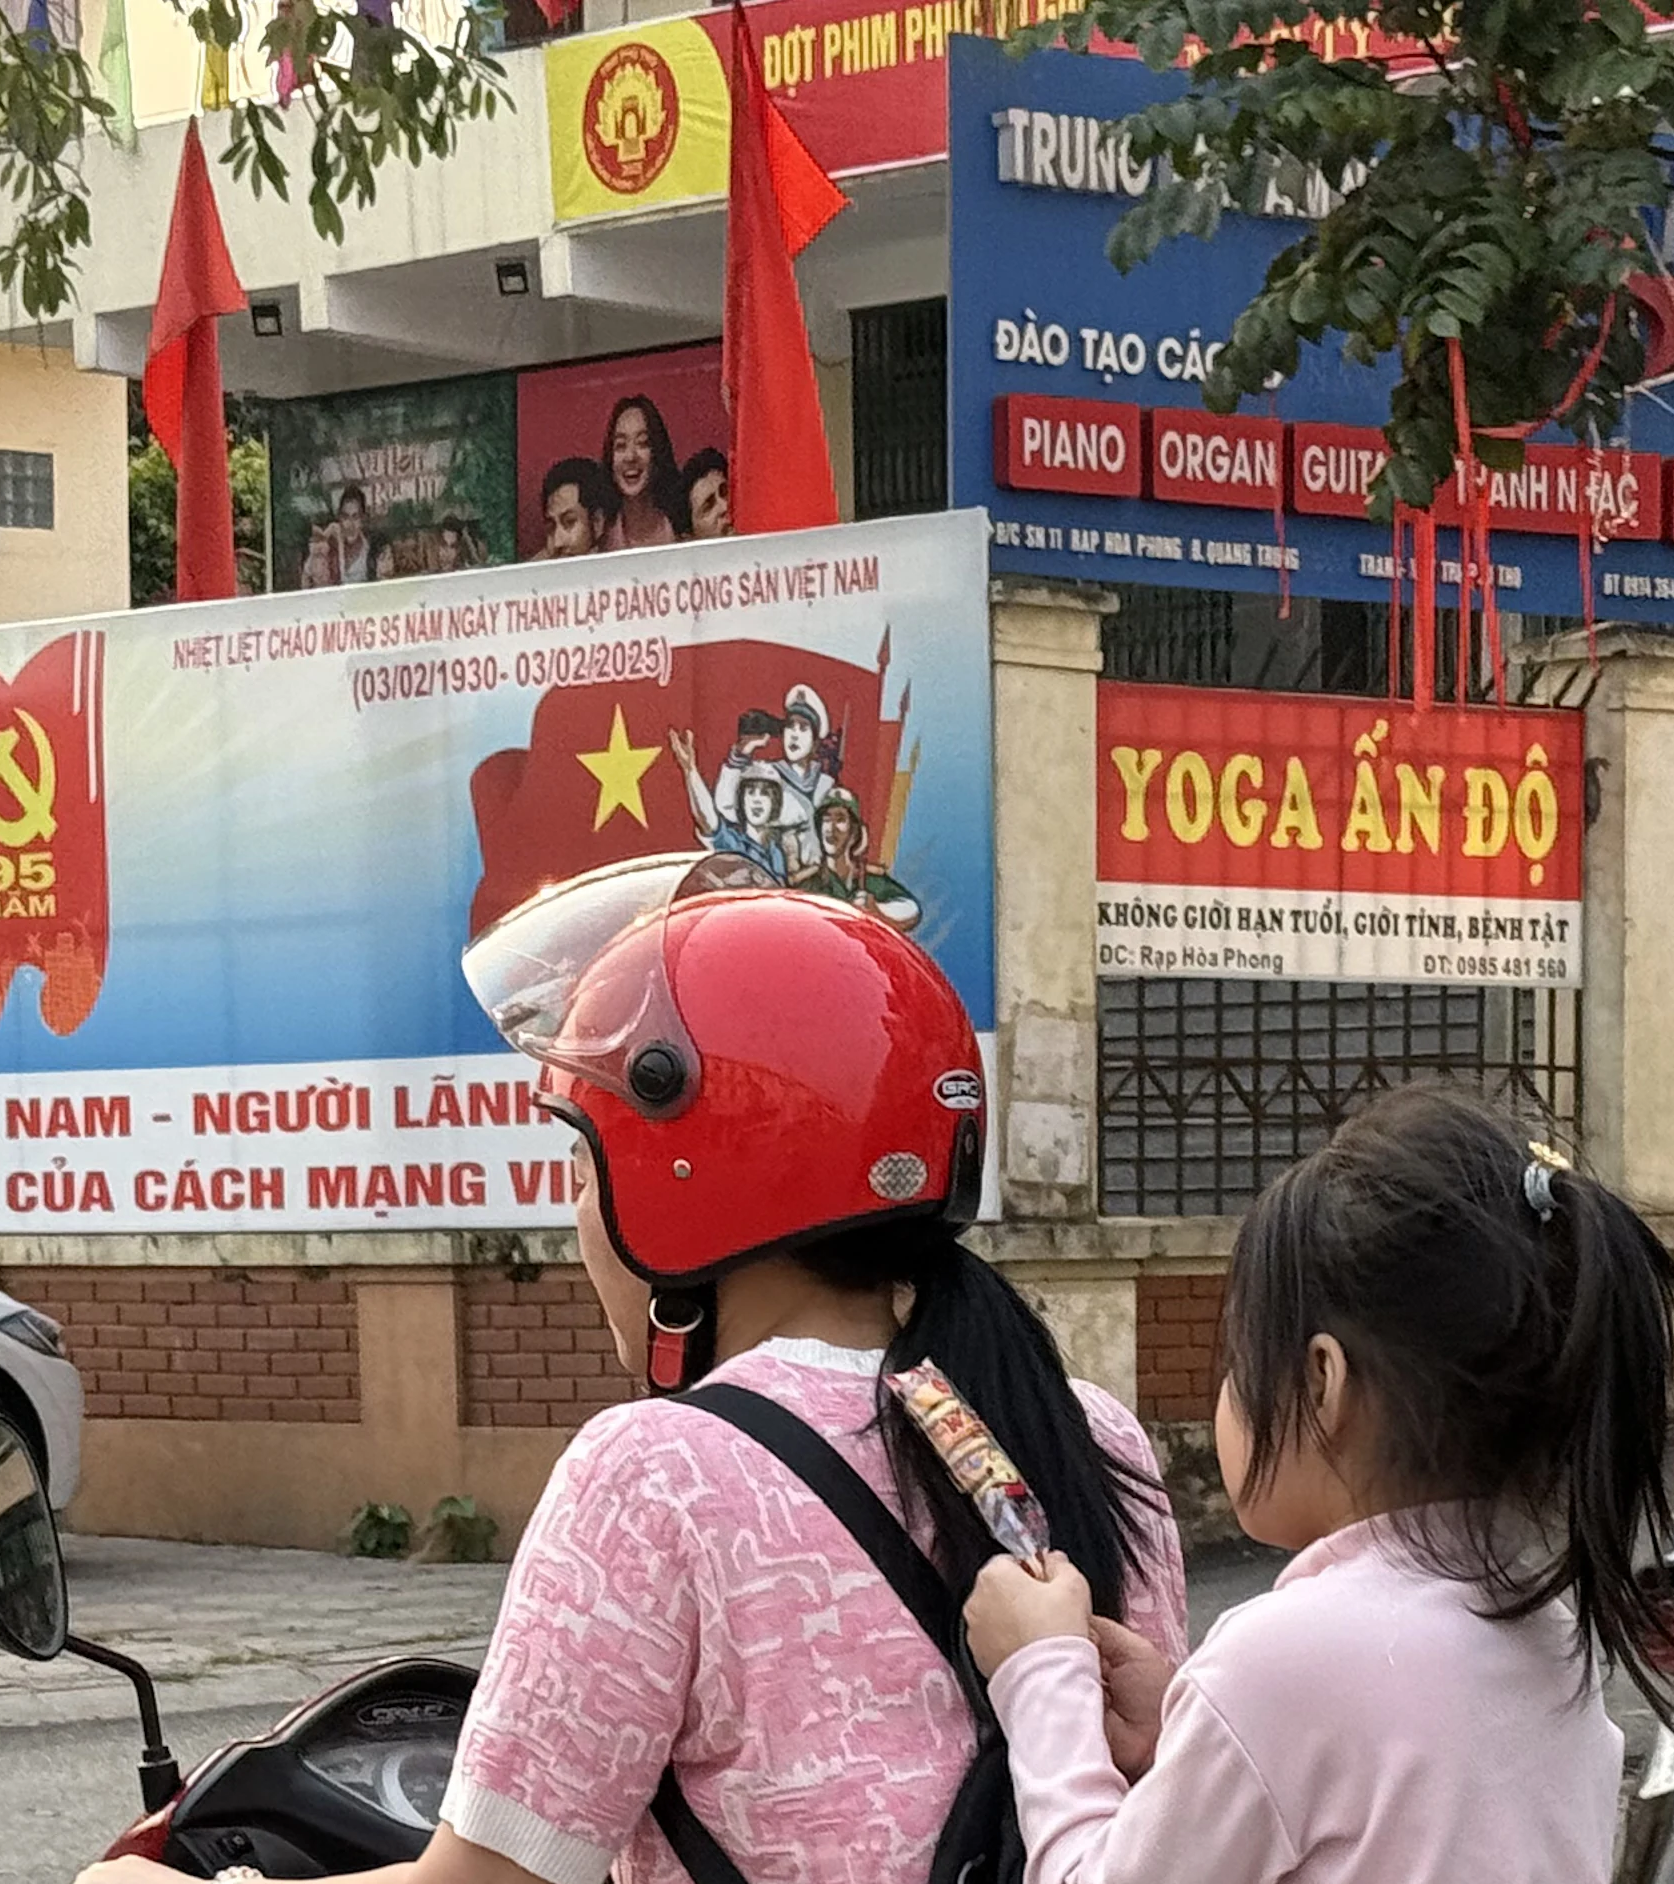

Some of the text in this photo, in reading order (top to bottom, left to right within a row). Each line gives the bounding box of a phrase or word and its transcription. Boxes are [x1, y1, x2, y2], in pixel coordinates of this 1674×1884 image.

[763, 23, 817, 98] ĐỢT
[824, 10, 898, 79] PHIM
[995, 307, 1070, 367] ĐÀO
[1079, 327, 1147, 384] TẠO
[1023, 416, 1126, 475] PIANO
[1159, 429, 1277, 488] ORGAN
[1302, 444, 1391, 497] GUIT
[379, 618, 402, 648] 95
[833, 555, 879, 597] NAM
[514, 637, 672, 687] 03/02/2025)
[1111, 718, 1560, 888] YOGA ẤN ĐỘ
[1097, 896, 1178, 927] KHÔNG
[1237, 907, 1286, 939] HẠN
[1467, 909, 1524, 946] BỆNH
[6, 1095, 131, 1139] NAM
[193, 1076, 370, 1135] NGƯỜI
[7, 1155, 115, 1212] CỦA
[134, 1159, 285, 1211] CÁCH
[307, 1162, 486, 1218] MẠNG
[507, 1160, 580, 1204] VI
